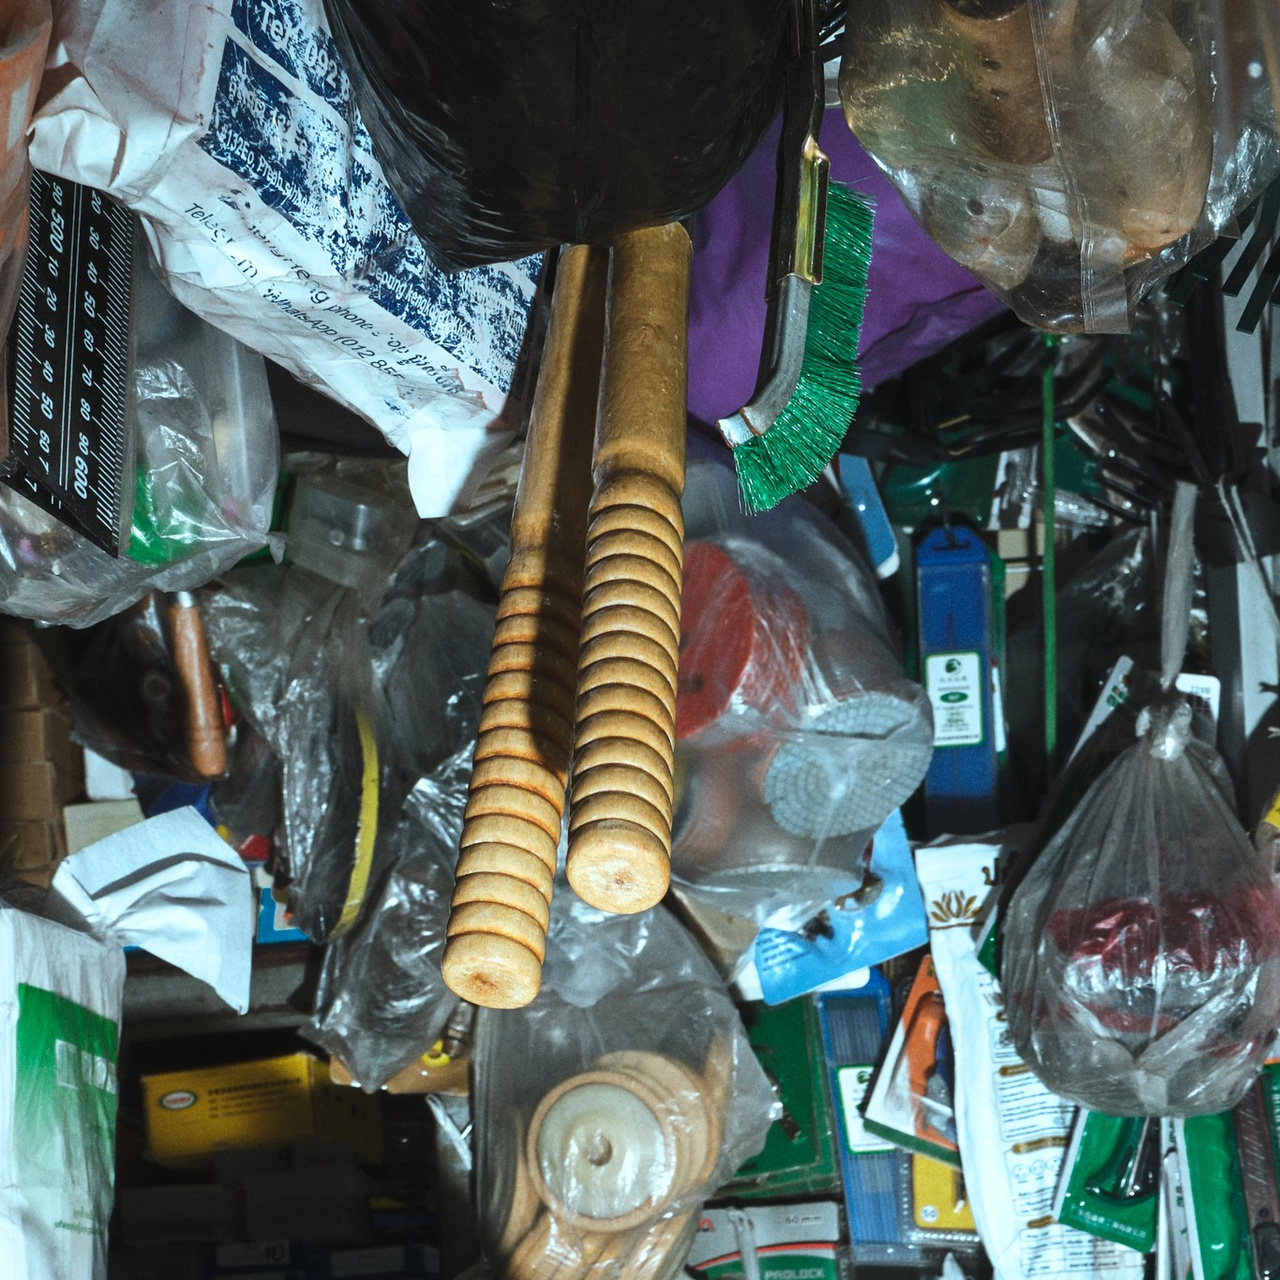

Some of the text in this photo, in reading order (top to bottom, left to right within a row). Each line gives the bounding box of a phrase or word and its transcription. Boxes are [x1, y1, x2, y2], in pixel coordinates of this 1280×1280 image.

[52, 182, 63, 206] 90
[50, 208, 65, 253] 500
[89, 226, 100, 250] 30
[48, 255, 59, 277] 10
[87, 261, 98, 284] 40
[46, 287, 58, 312] 20
[83, 290, 96, 318] 50
[325, 303, 372, 330] phone
[44, 324, 56, 348] 30
[83, 329, 94, 352] 60
[42, 360, 54, 383] 40
[81, 364, 93, 387] 70
[40, 392, 54, 420] 50
[80, 398, 91, 421] 80
[39, 429, 51, 453] 60
[78, 433, 90, 456] 90
[74, 455, 89, 500] 600
